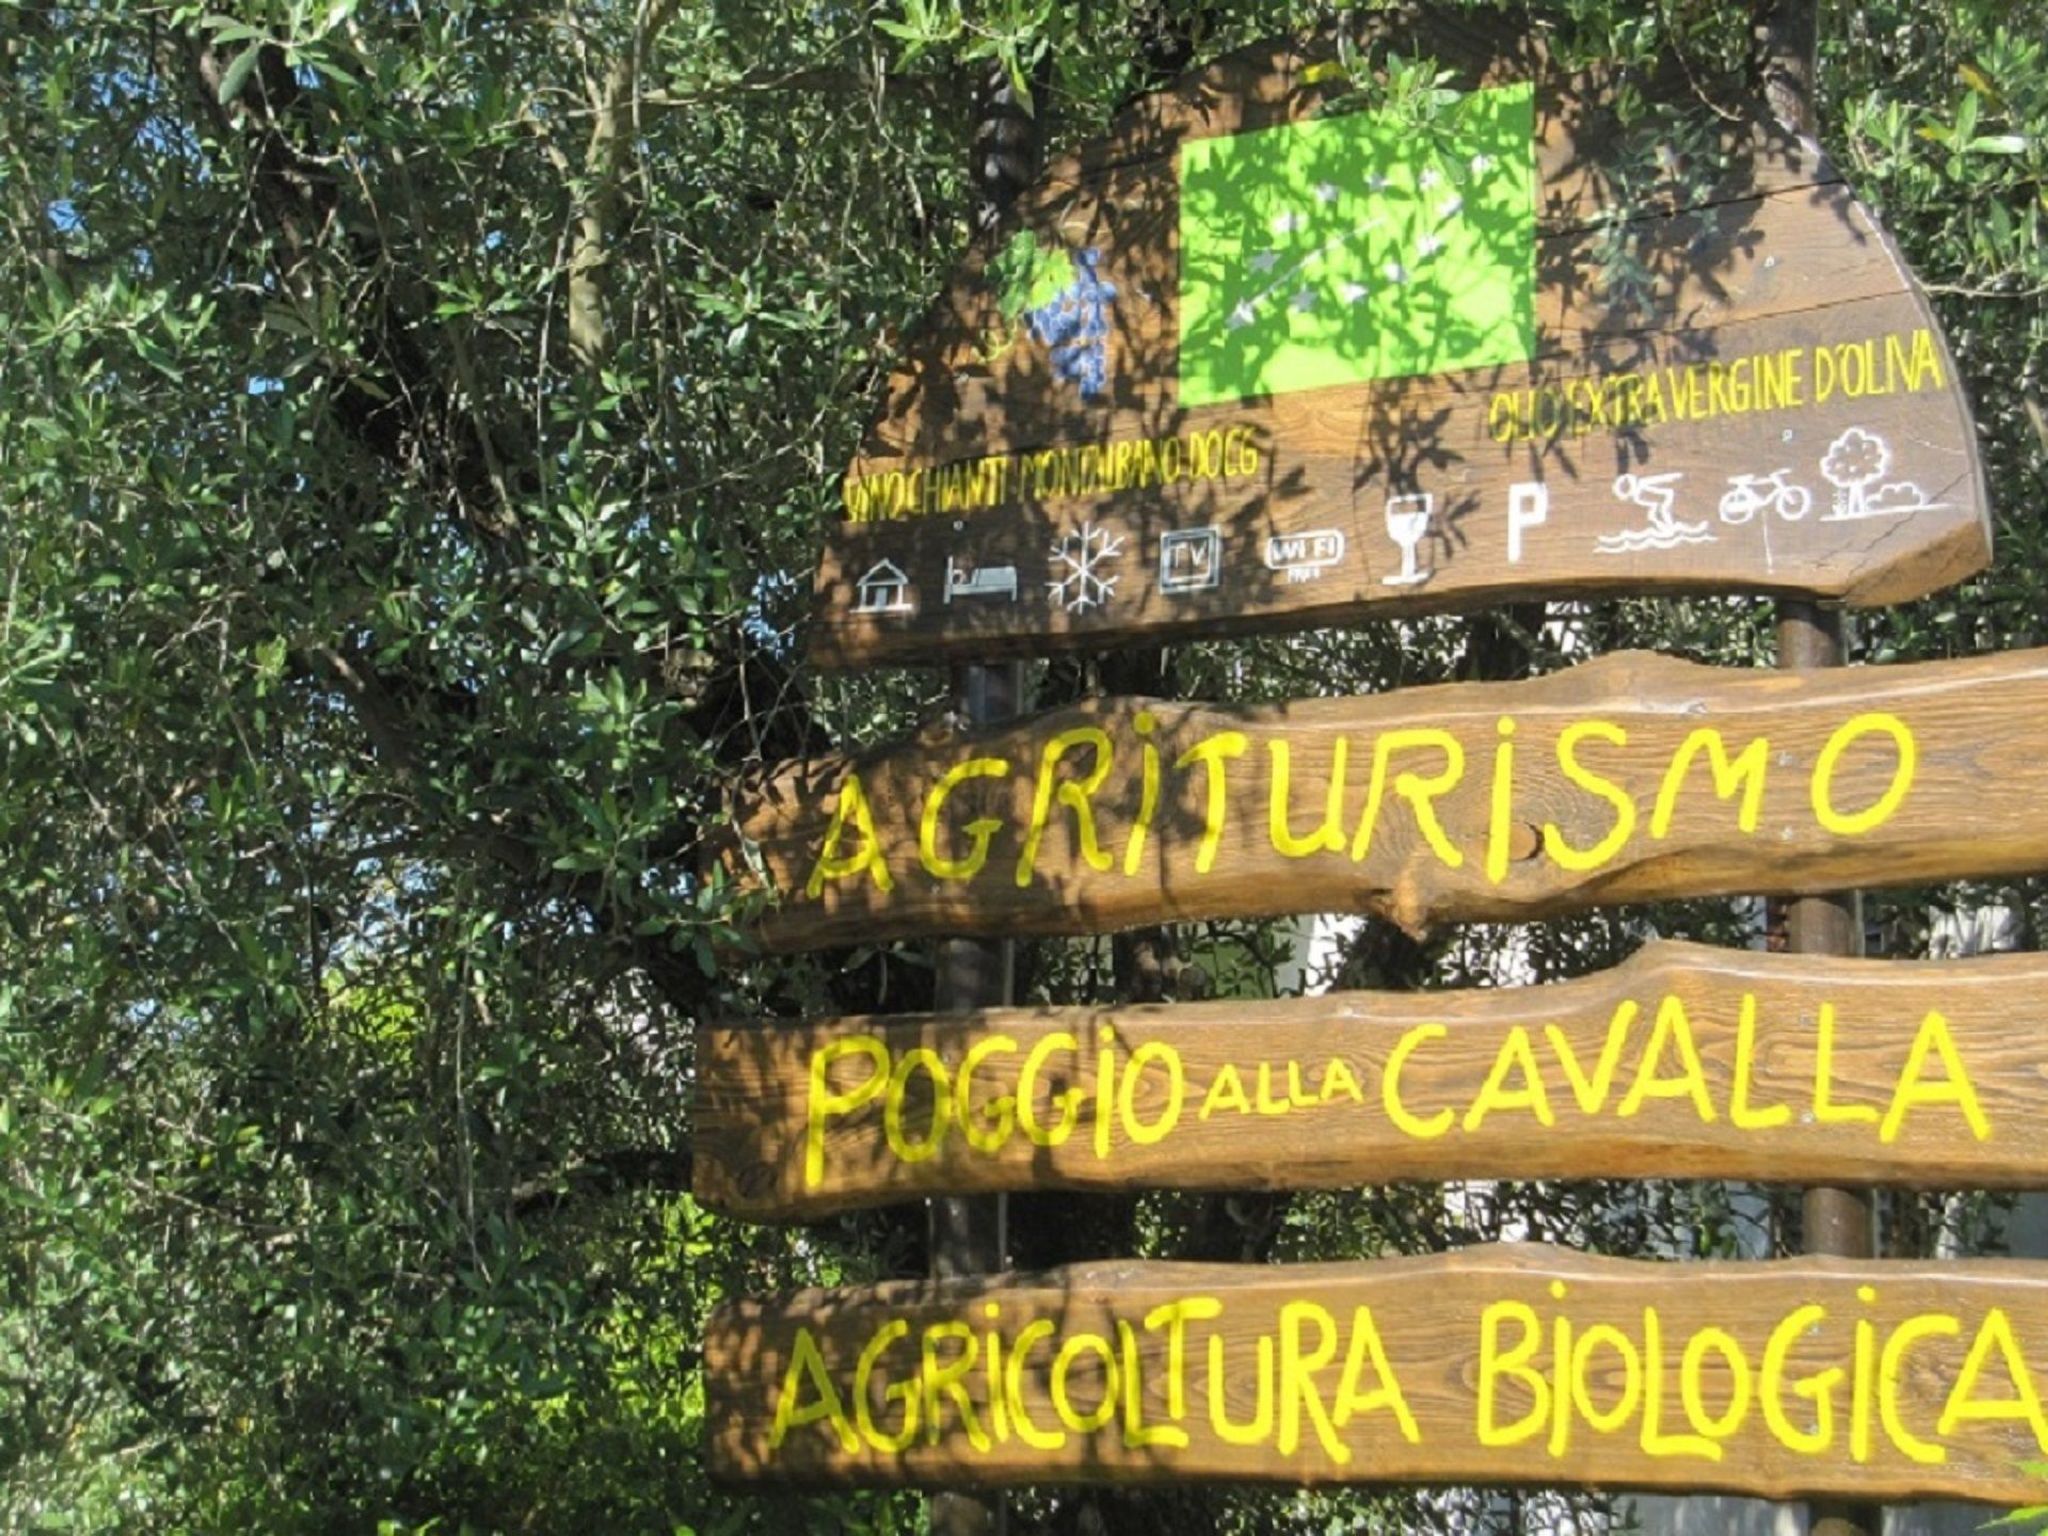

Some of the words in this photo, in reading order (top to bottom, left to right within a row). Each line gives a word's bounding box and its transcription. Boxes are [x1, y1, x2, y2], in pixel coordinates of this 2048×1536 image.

[1563, 371, 1668, 438] EXTRA
[1666, 348, 1804, 422] VERGINE
[1815, 329, 1945, 403] D'OLIVA
[1188, 423, 1260, 481] DOCG
[1169, 540, 1209, 568] TV
[1508, 482, 1548, 565] P
[1200, 1056, 1364, 1121] ALLA
[1381, 992, 1992, 1144] CAVALLA
